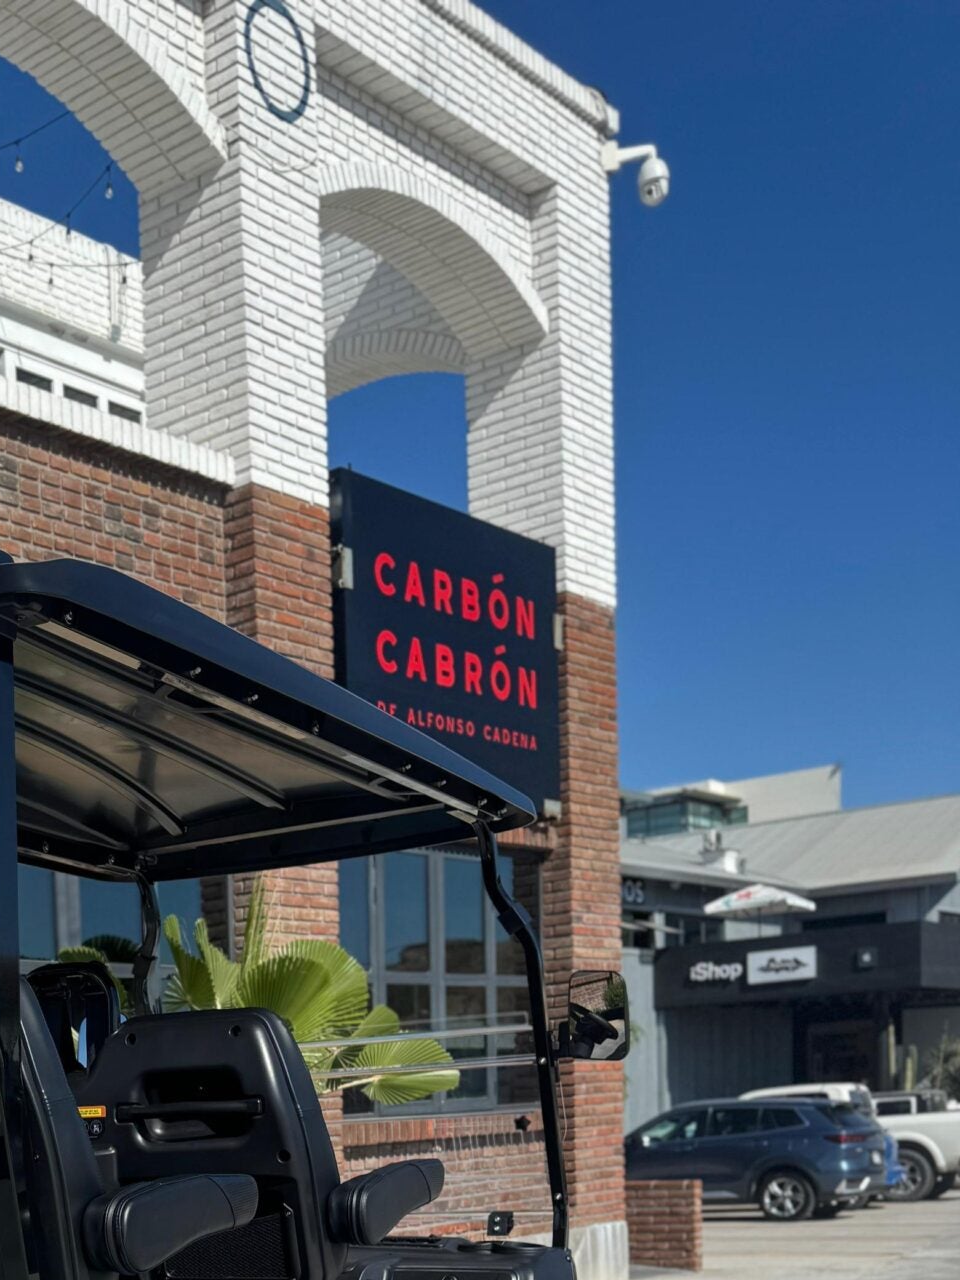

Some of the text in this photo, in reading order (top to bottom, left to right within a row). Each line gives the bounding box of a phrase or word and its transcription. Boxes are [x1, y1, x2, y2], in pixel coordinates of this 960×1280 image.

[374, 552, 536, 640] CARBÓN
[376, 630, 537, 710] CABRÓN
[407, 708, 476, 737] ALFONSO
[483, 725, 537, 749] CADENA
[690, 961, 743, 982] iShop
